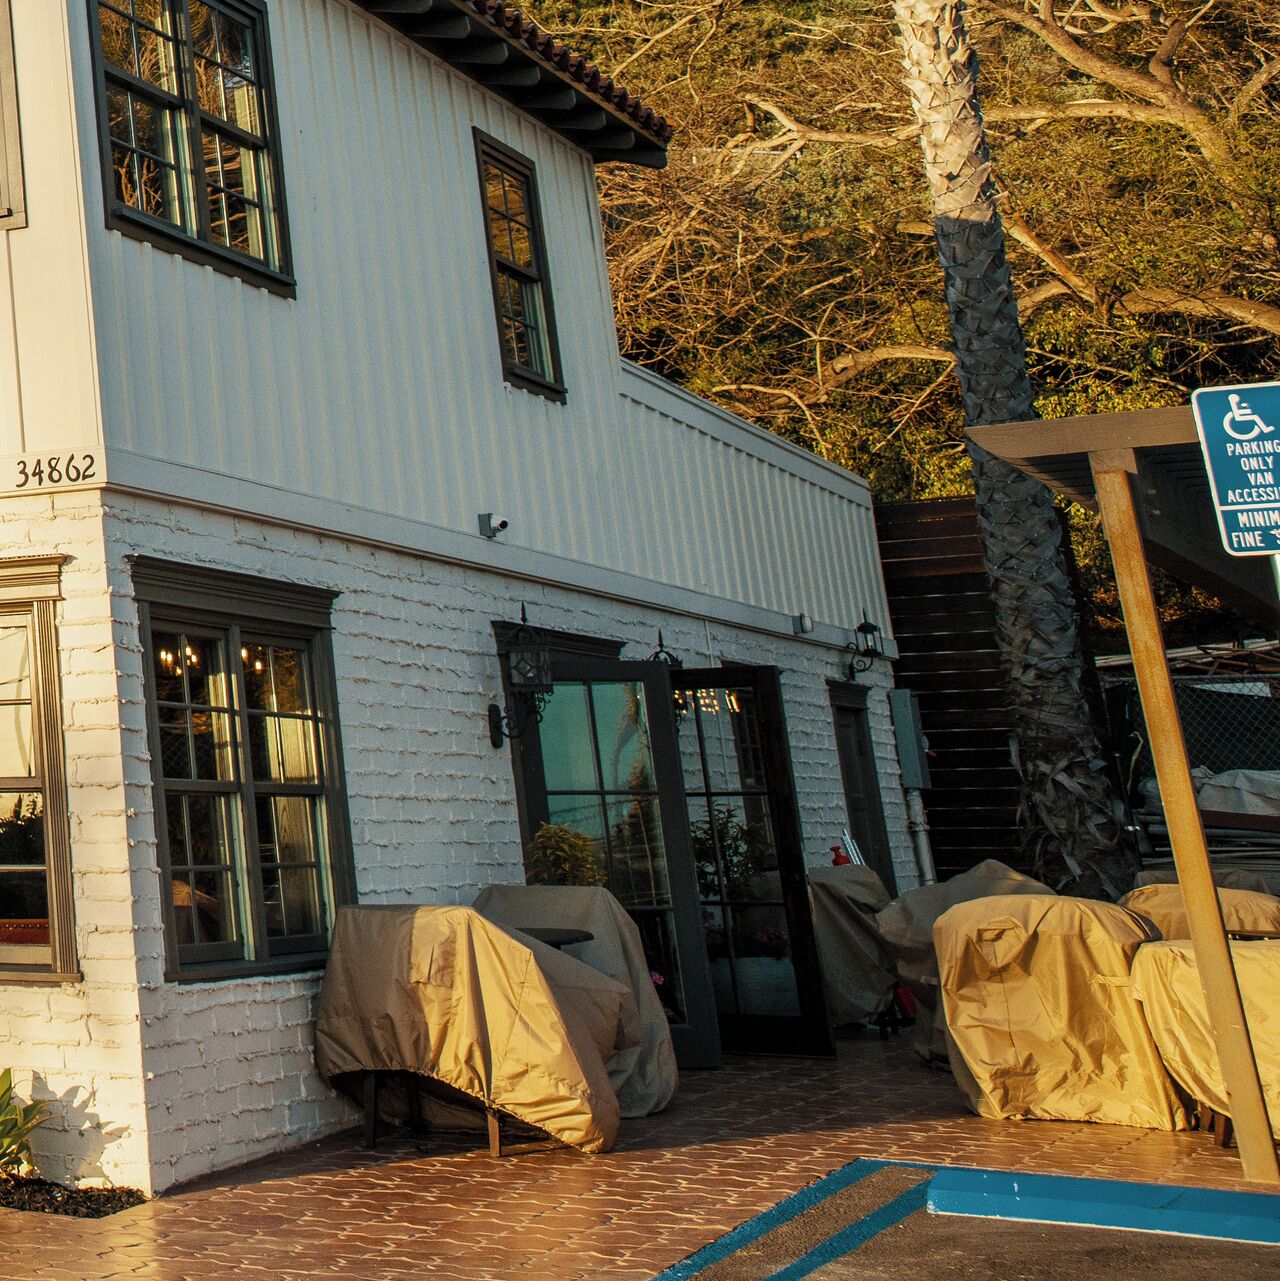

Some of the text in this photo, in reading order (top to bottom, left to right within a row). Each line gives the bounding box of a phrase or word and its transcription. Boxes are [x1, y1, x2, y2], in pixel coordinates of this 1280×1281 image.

[1226, 440, 1280, 456] PARKING
[16, 453, 96, 488] 34862
[1241, 456, 1274, 471] ONLY
[1247, 472, 1274, 486] VAN
[1228, 487, 1280, 503] ACCESSI
[1231, 531, 1265, 548] FINE
